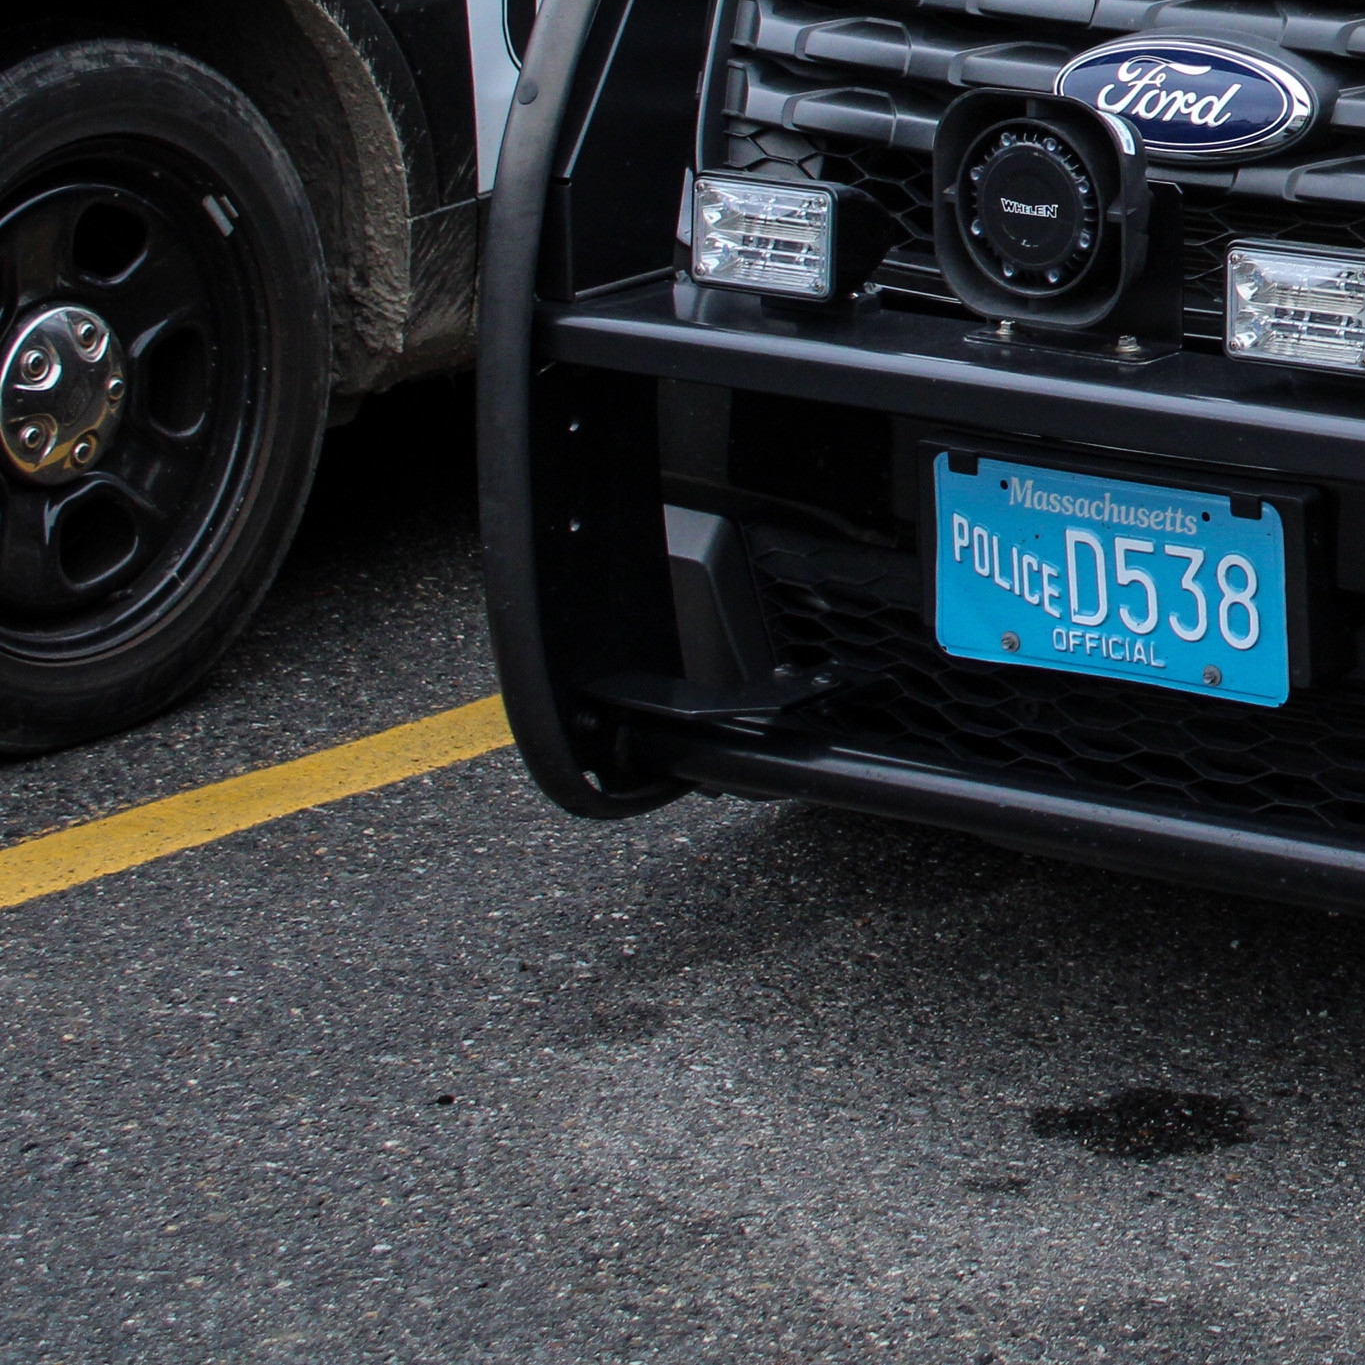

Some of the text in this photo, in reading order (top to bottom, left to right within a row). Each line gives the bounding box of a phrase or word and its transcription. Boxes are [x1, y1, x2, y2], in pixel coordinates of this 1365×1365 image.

[1097, 55, 1242, 129] Ford
[1001, 198, 1059, 219] WHELEN
[1009, 476, 1197, 536] Massachusetts
[952, 512, 1261, 651] POLICE D538
[1052, 626, 1167, 669] OFFICIAL
